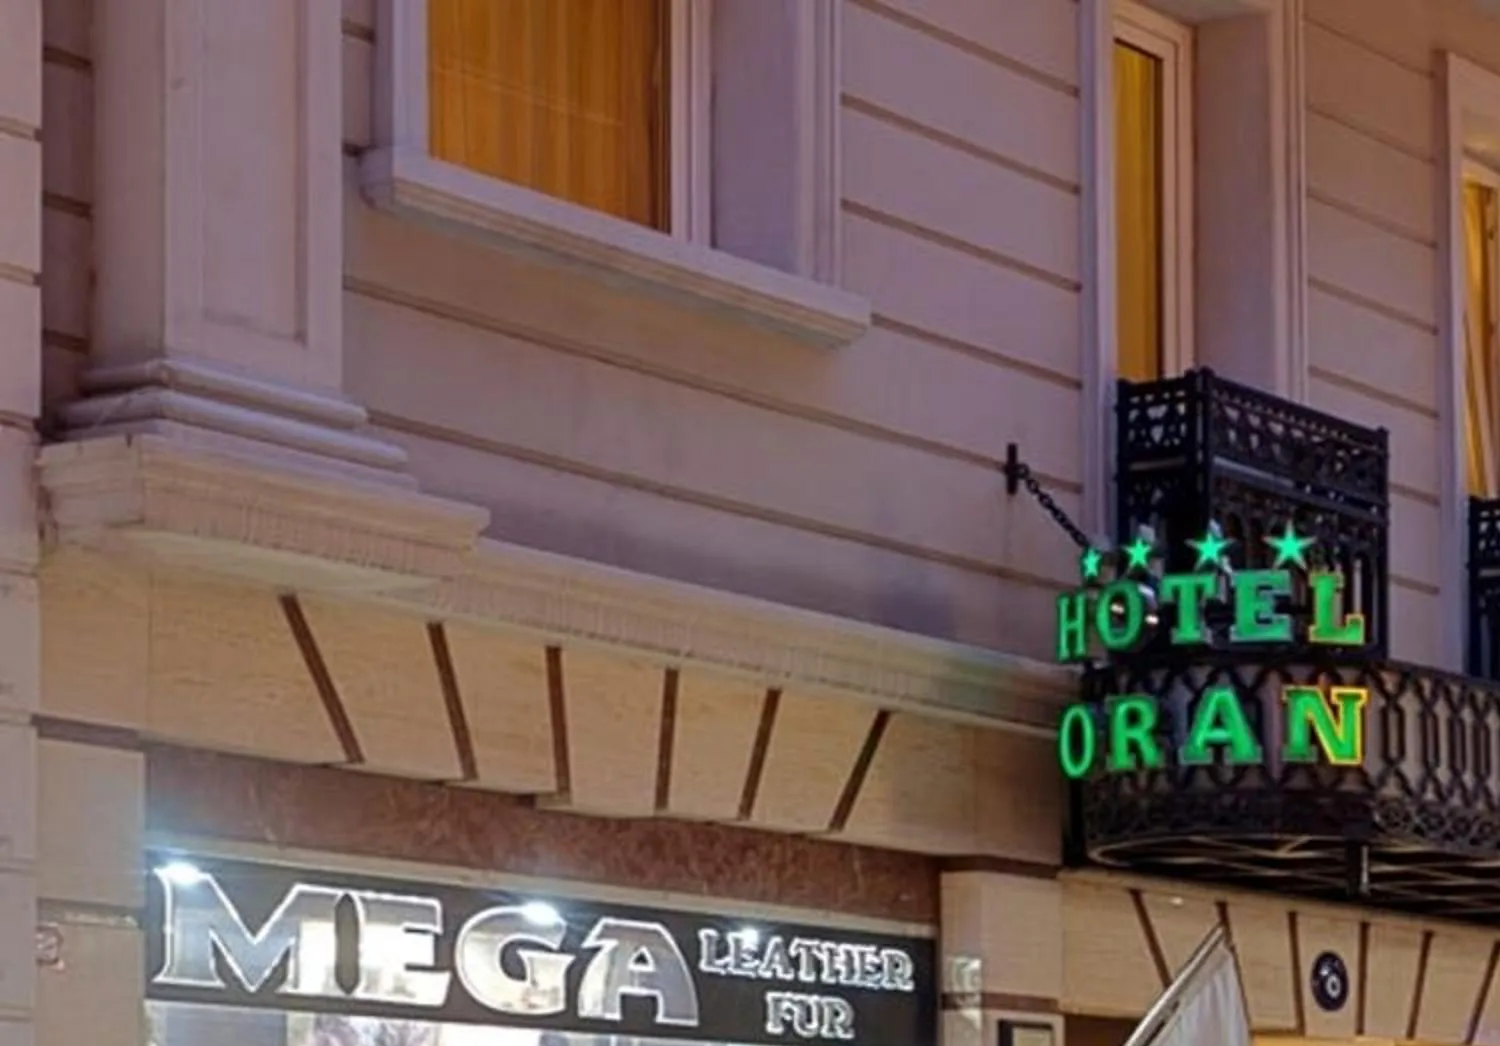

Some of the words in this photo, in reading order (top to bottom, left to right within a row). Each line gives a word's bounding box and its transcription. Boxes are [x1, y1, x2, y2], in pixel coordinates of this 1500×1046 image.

[1057, 569, 1366, 663] HOTEL
[1058, 685, 1369, 779] ORAN
[153, 864, 700, 1026] MEGA
[698, 929, 915, 991] LEATHER
[765, 991, 855, 1039] FUR
